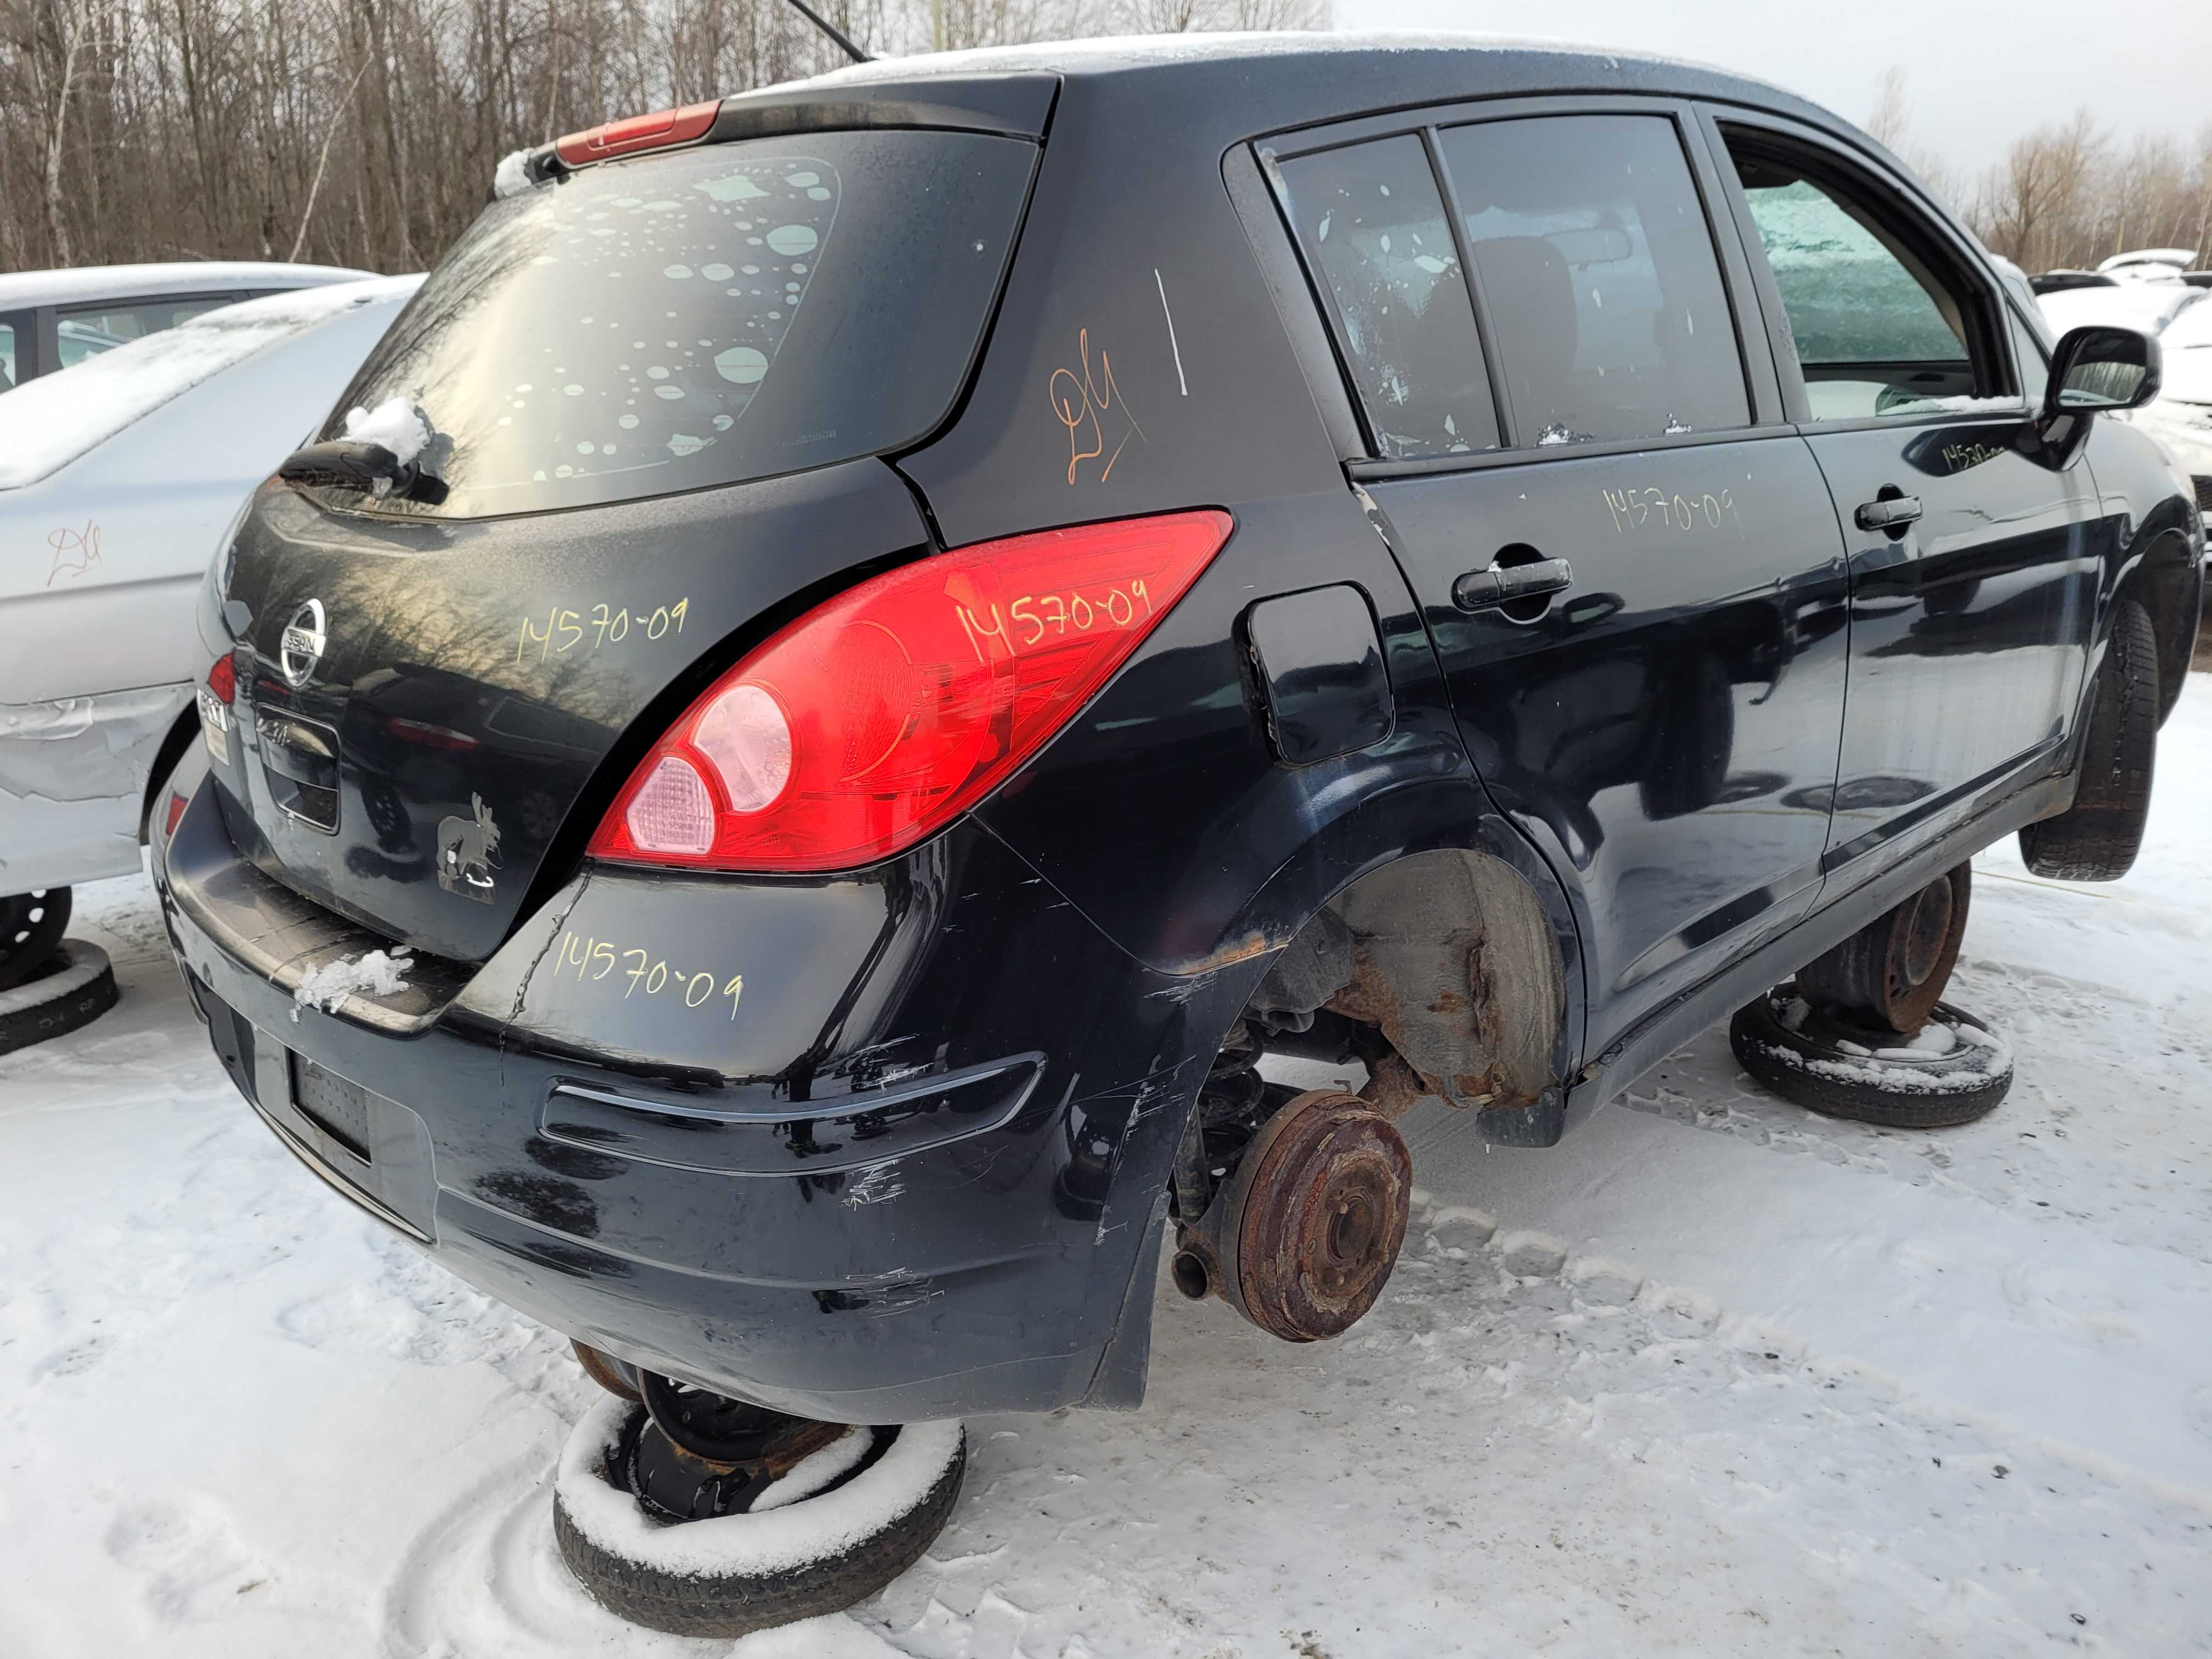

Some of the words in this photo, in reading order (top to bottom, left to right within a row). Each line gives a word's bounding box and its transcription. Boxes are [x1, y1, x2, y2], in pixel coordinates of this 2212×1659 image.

[1602, 487, 1745, 541] 14570-09
[516, 597, 689, 663] 14570-09
[955, 579, 1153, 665] 14570-09
[553, 931, 744, 1021] 14570-09
